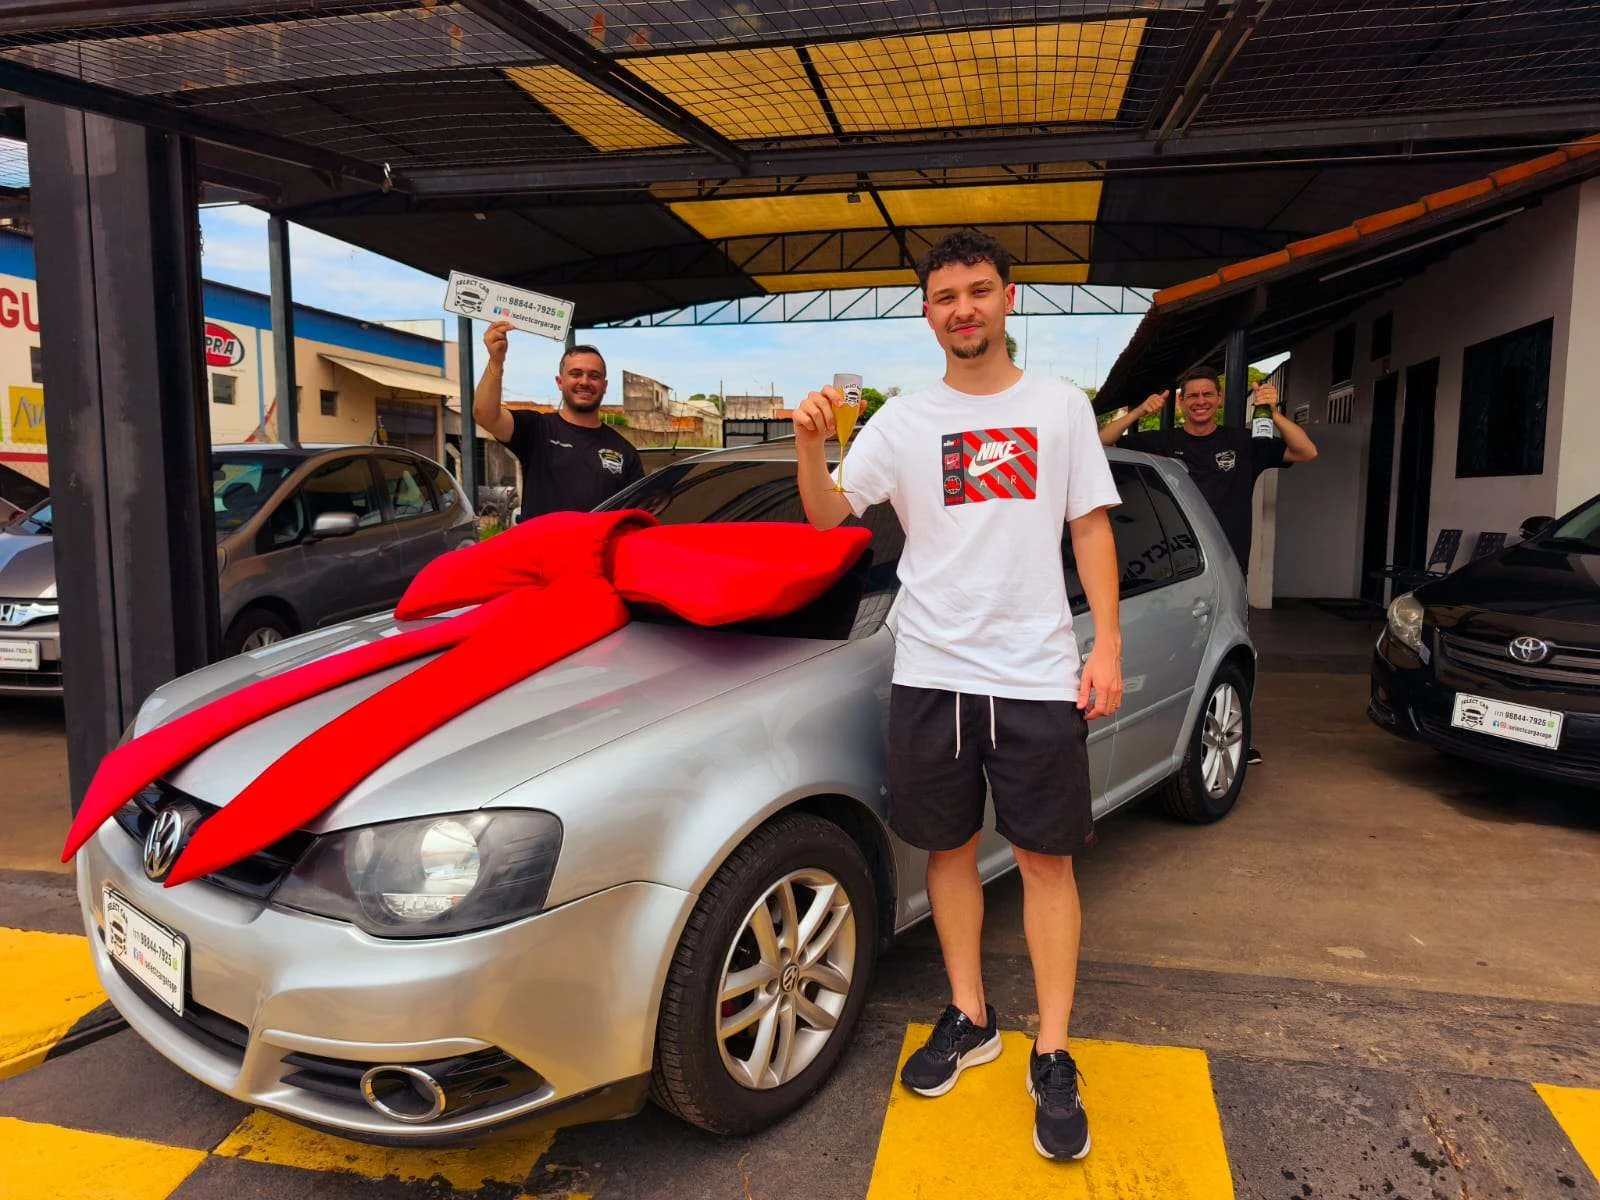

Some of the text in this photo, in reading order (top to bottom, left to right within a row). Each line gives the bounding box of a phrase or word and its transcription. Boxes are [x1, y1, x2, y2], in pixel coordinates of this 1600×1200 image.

[456, 279, 478, 287] SELECT
[508, 297, 556, 316] 98844-7925
[976, 440, 1017, 462] NIKE
[1504, 711, 1547, 727] 98844-7925
